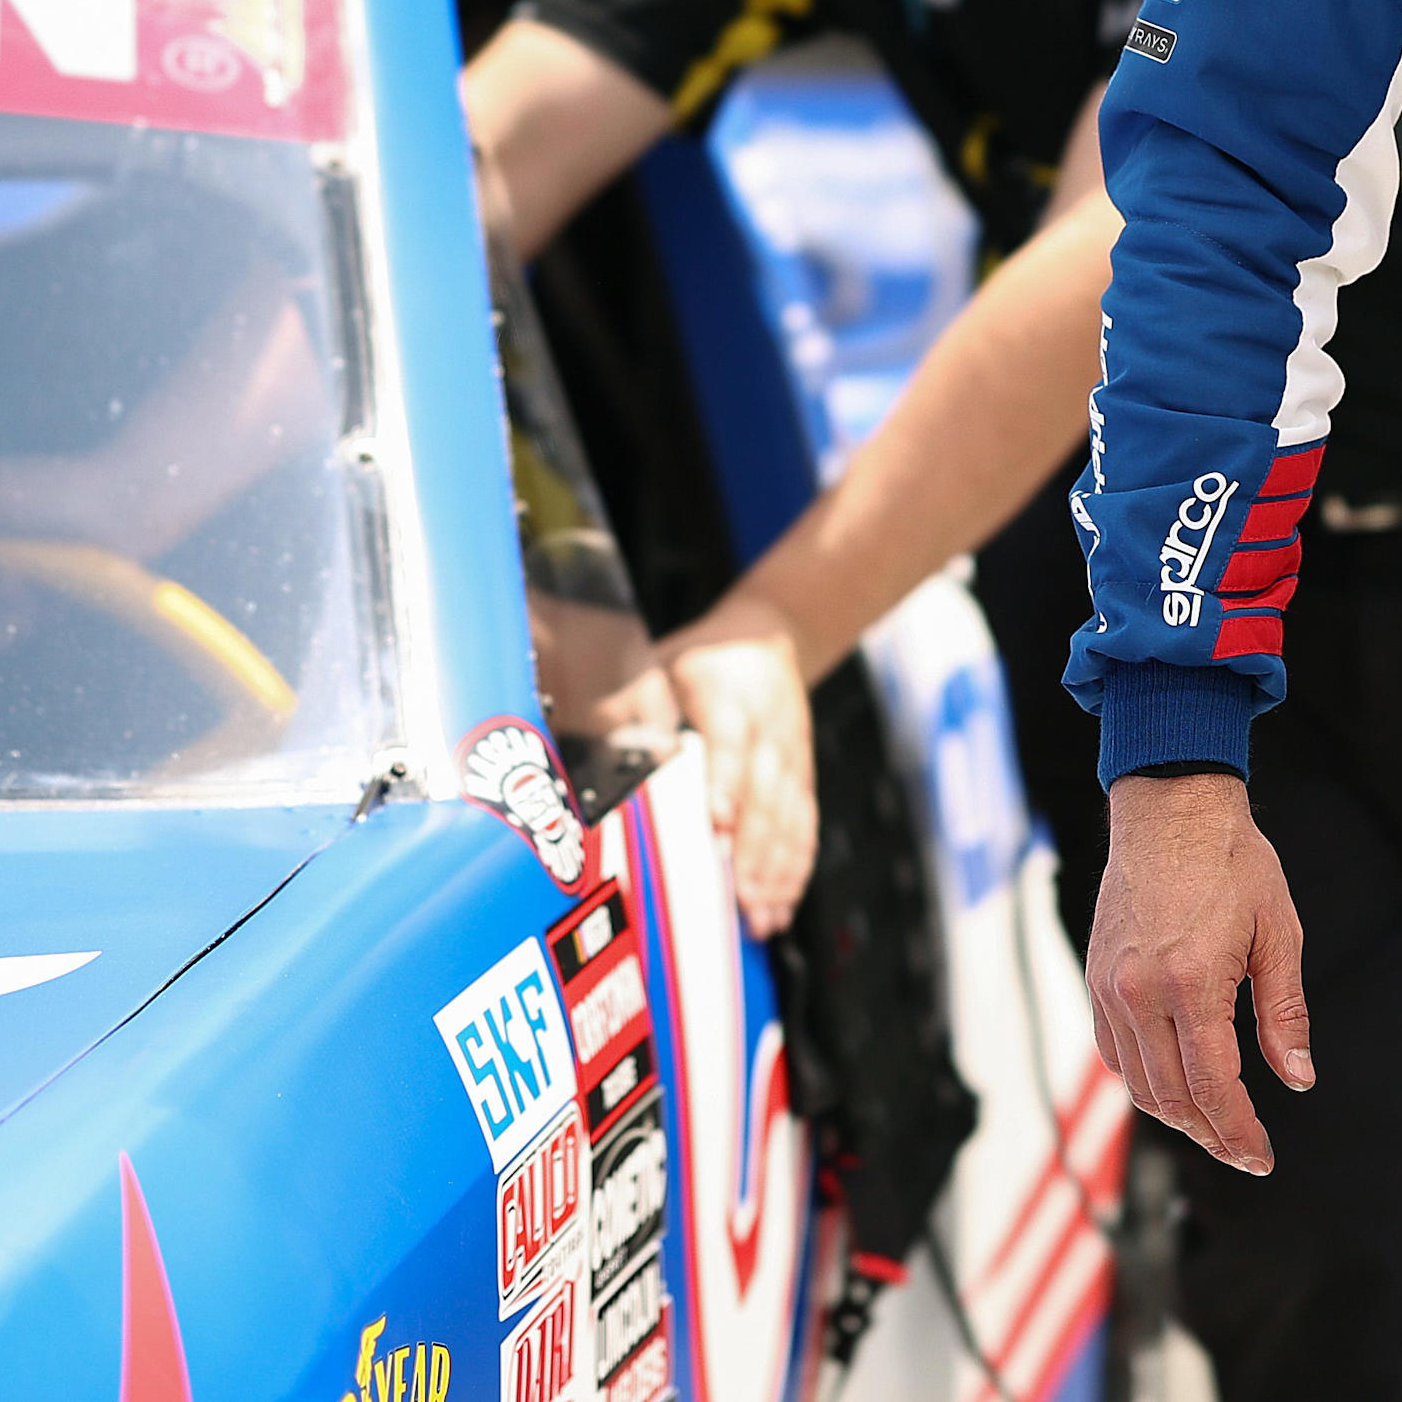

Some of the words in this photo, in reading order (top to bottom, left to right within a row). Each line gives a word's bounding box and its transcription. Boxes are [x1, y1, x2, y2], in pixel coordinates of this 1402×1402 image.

[1160, 471, 1231, 627] sparco
[456, 969, 551, 1142] SKF
[502, 1118, 579, 1298] CALICO
[341, 1342, 451, 1402] YEAR
